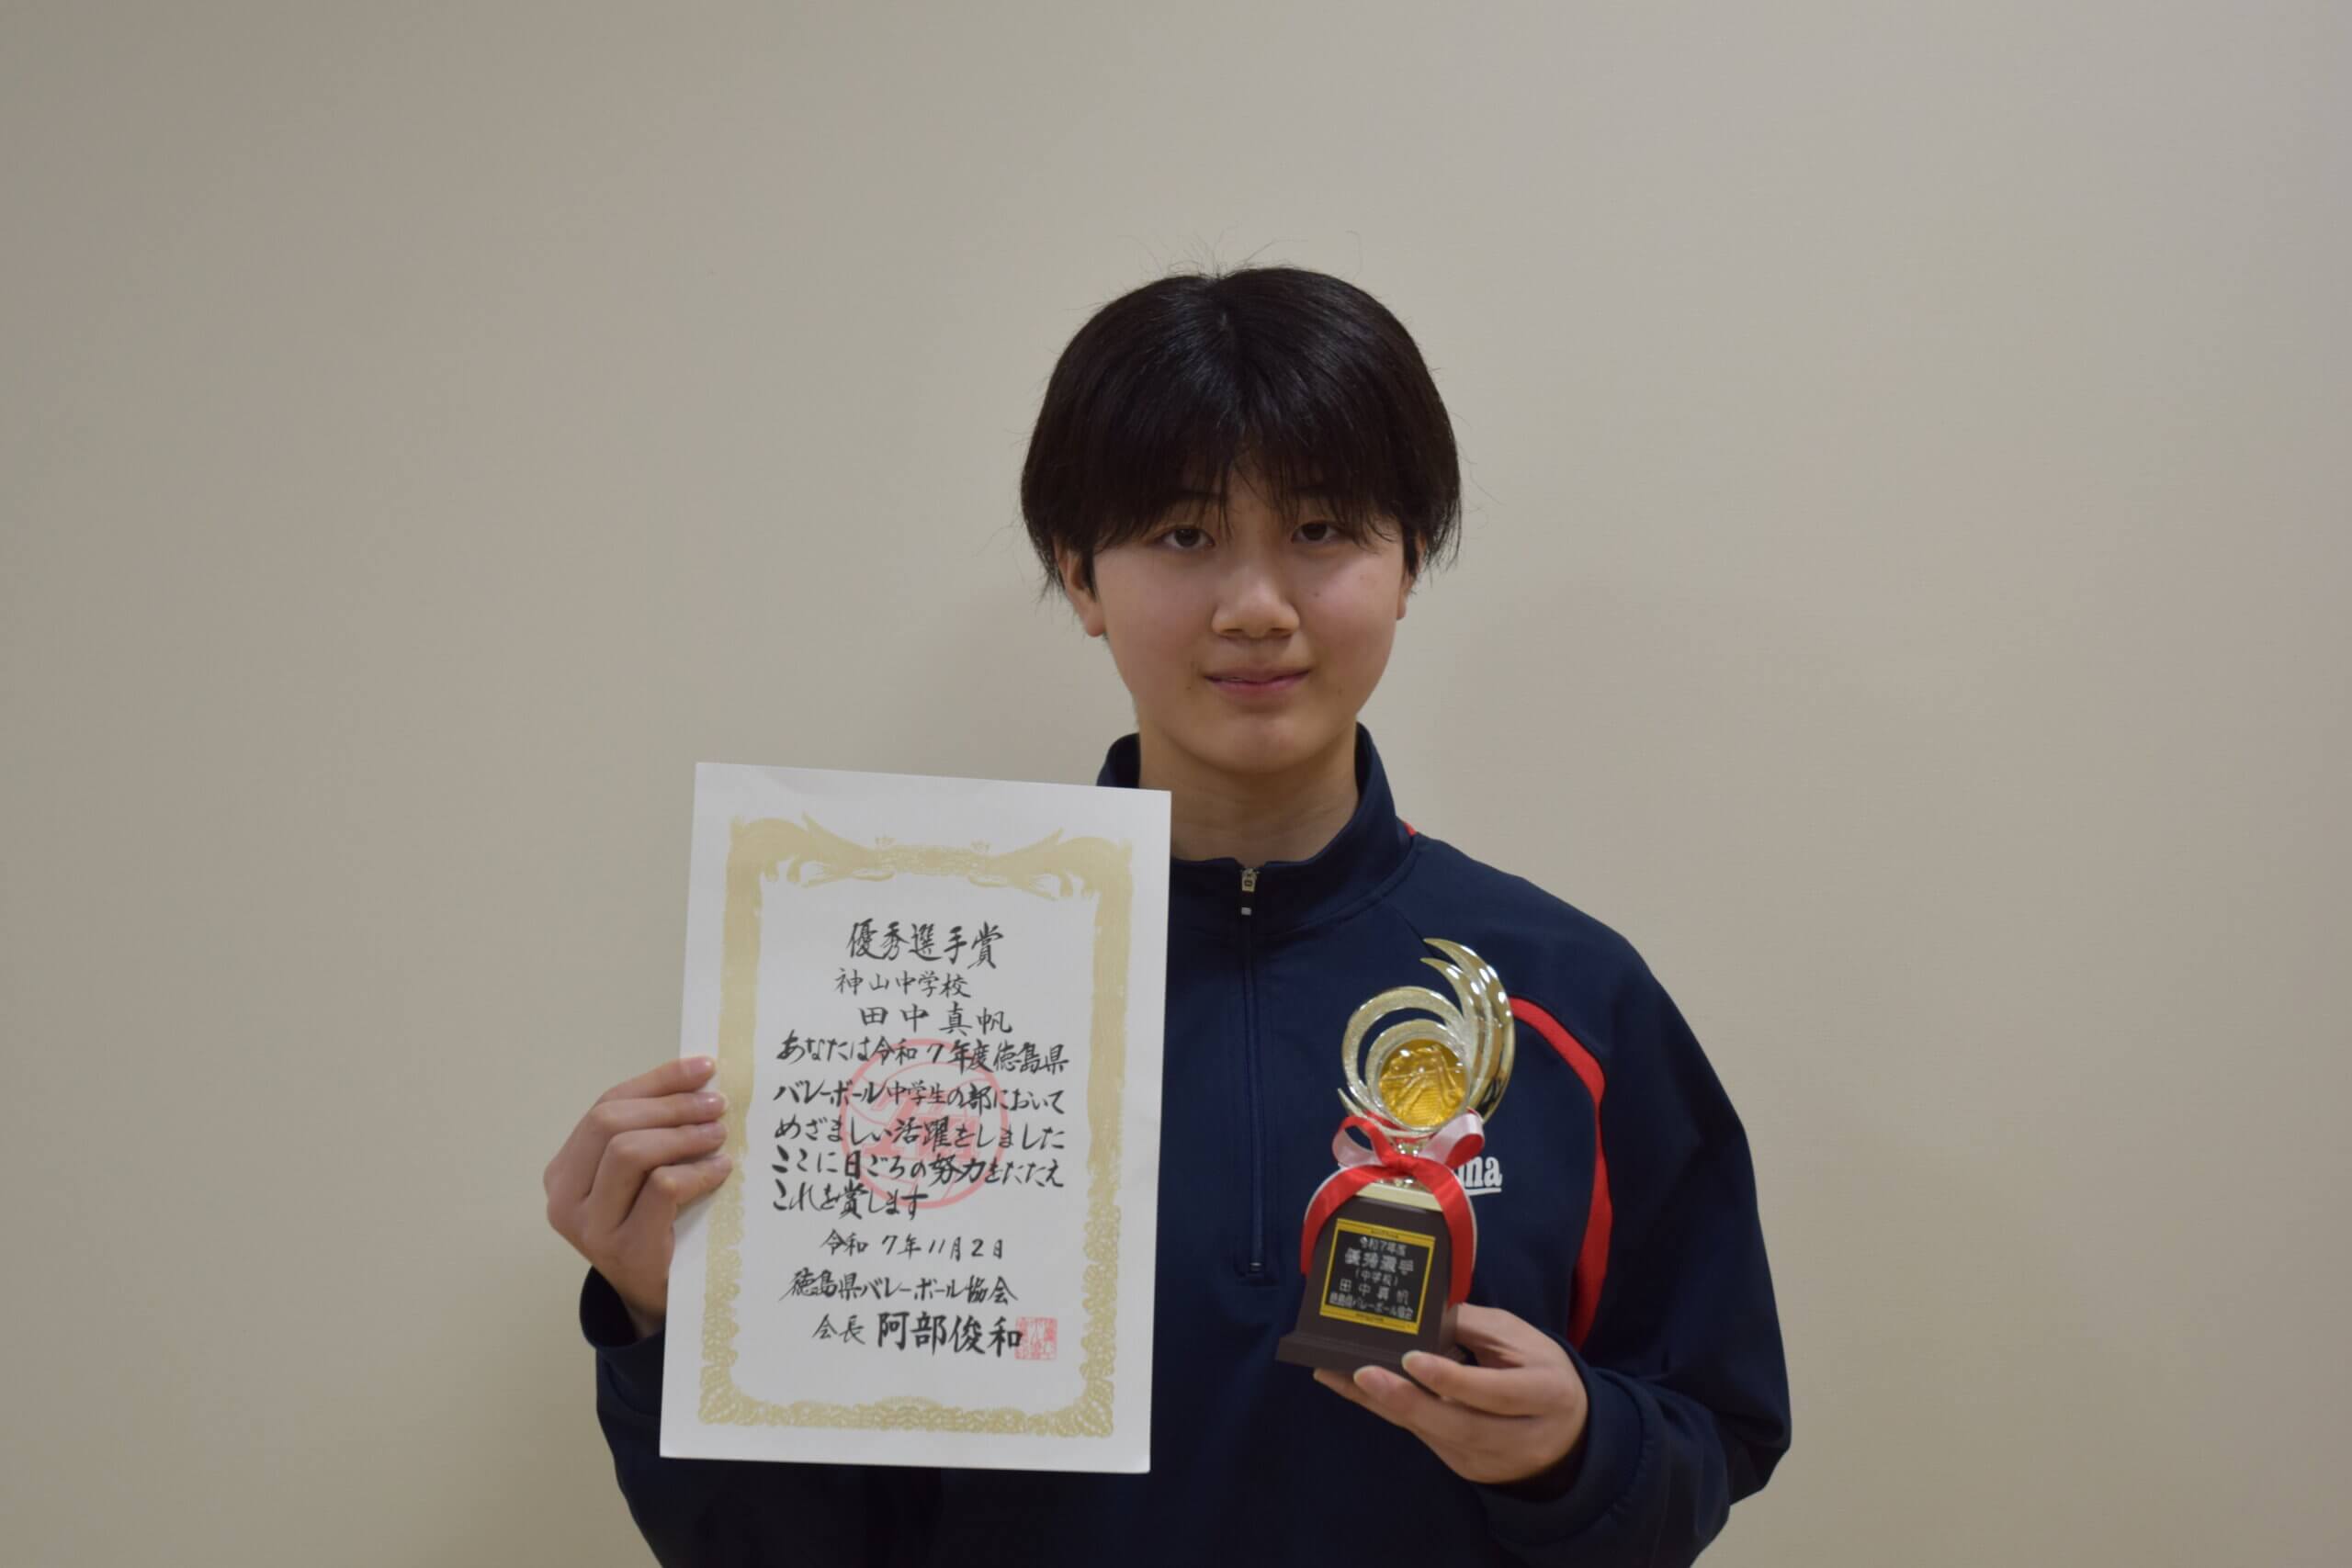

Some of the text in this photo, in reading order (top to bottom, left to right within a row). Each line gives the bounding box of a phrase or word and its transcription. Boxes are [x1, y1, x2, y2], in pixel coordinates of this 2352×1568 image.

[846, 918, 1004, 969] 優秀選手賞
[834, 968, 971, 998] 神山中学校
[858, 1001, 1013, 1035] 田中真帆
[776, 1029, 1069, 1075] あなたは令和7年度徳島県
[774, 1079, 1065, 1115] バレーボール中学生の部において
[775, 1113, 1065, 1150] めざましい活躍をしました
[772, 1145, 1065, 1188] ここに日ごろの努力をたたえ
[773, 1179, 928, 1220] これを賞します
[779, 1267, 1018, 1305] 徳島県バレーボール協会
